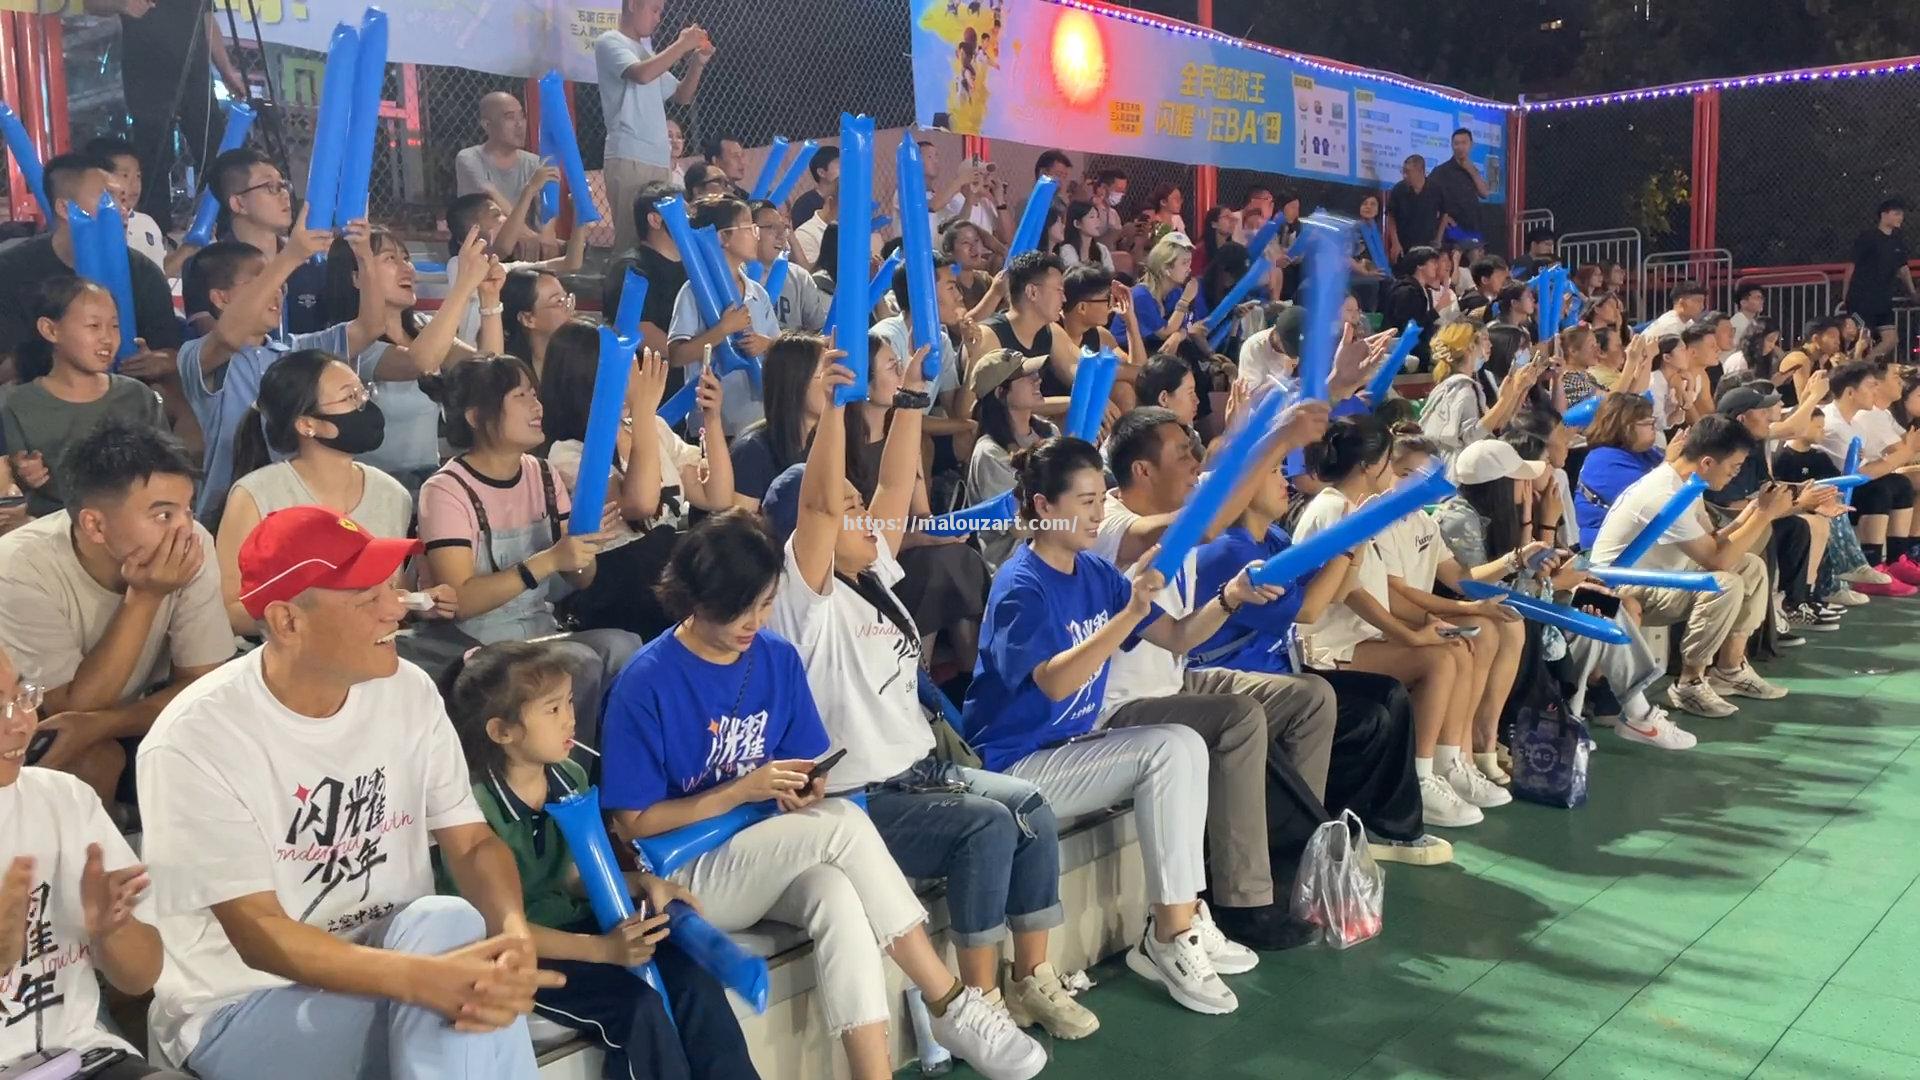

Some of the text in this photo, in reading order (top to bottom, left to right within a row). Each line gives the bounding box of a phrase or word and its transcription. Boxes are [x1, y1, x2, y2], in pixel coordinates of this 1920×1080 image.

[1180, 61, 1266, 104] 全民篮球王
[285, 766, 387, 848] 闪耀
[297, 836, 388, 924] 少年
